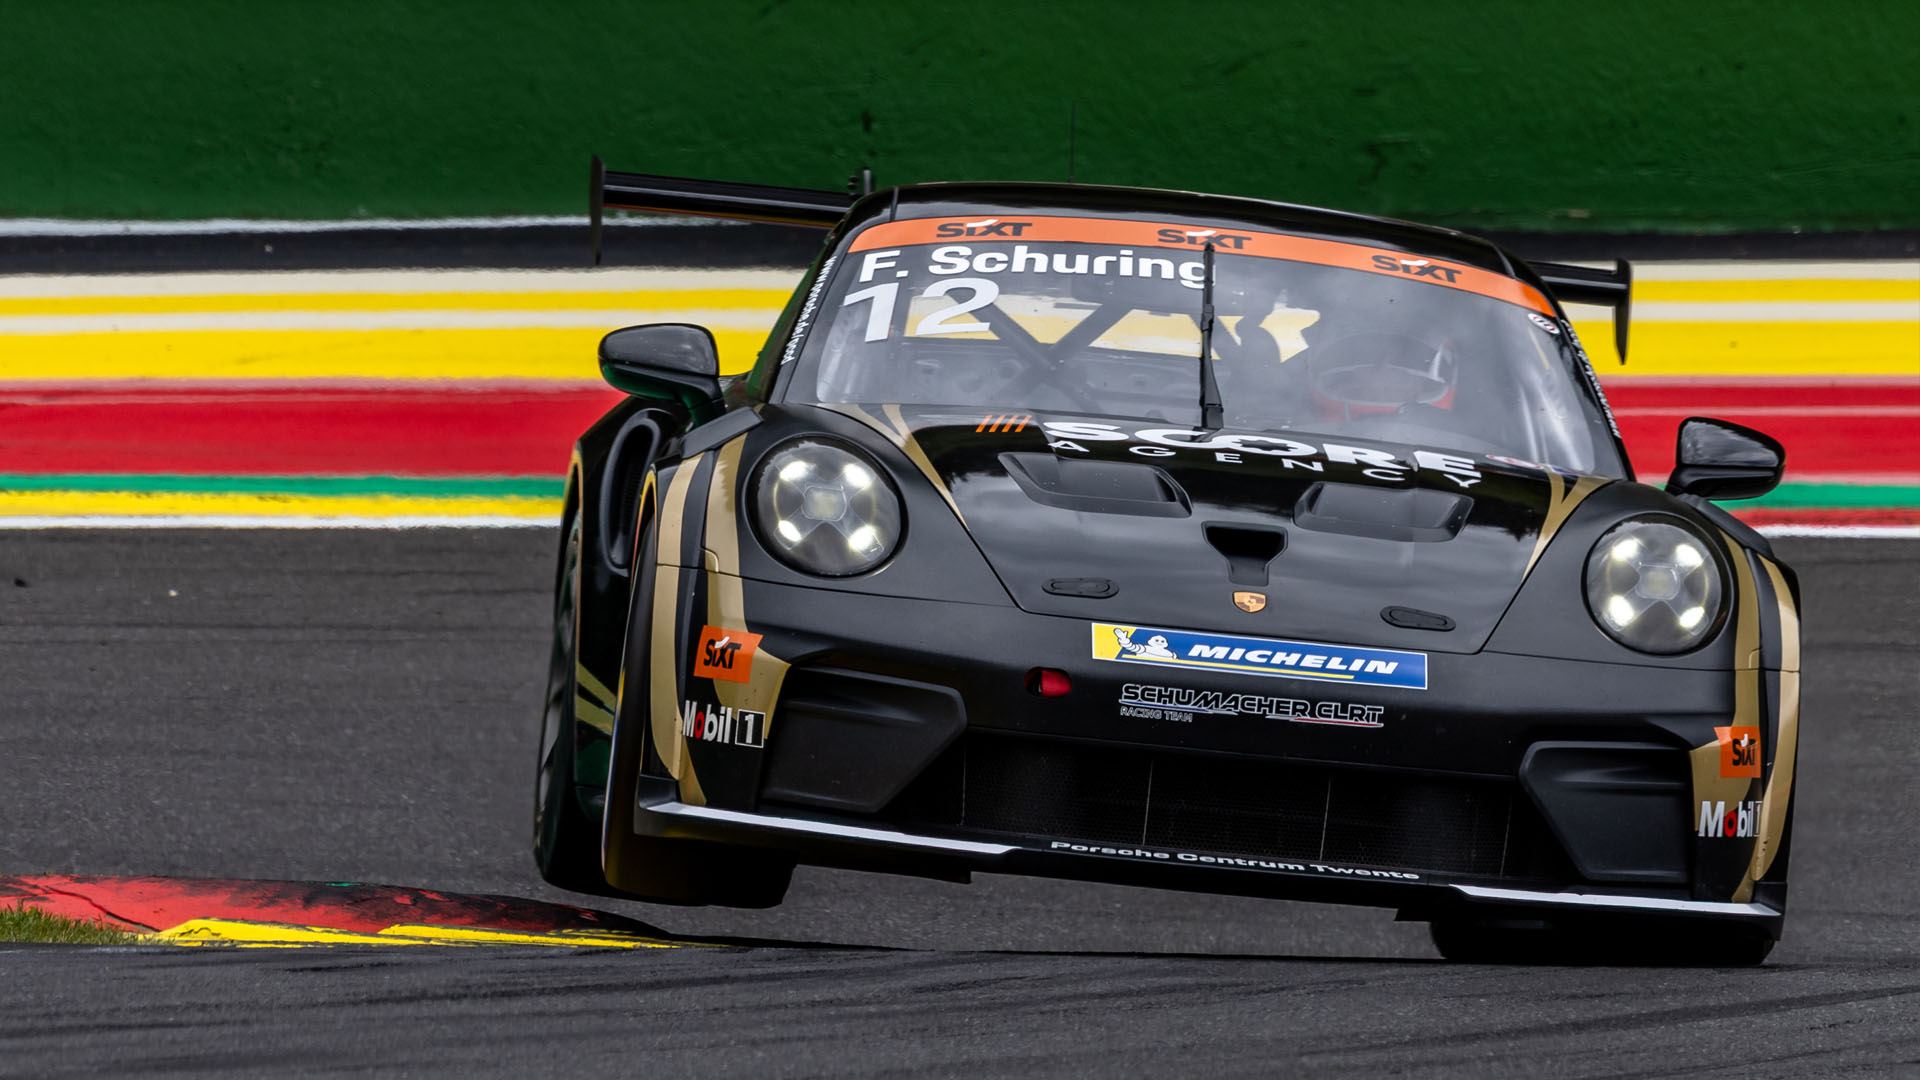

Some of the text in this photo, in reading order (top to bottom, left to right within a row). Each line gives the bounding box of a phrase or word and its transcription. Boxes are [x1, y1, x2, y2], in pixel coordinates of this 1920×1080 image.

[936, 219, 1032, 238] SIXT
[1157, 230, 1252, 249] SIXT
[859, 245, 1216, 289] F. Schuring
[1372, 255, 1462, 283] SIXT
[843, 277, 999, 342] 12
[1043, 421, 1482, 478] SCORE
[1048, 440, 1482, 488] AGENCY
[703, 636, 742, 669] SIXT
[1188, 644, 1399, 674] MICHELIN
[682, 700, 732, 743] Mobil
[1120, 706, 1193, 723] RACING TEAM
[1122, 683, 1384, 724] SCHUMACHER CLRT
[1698, 801, 1754, 838] Mobil
[1051, 841, 1420, 880] Porsche Centrum Twente
